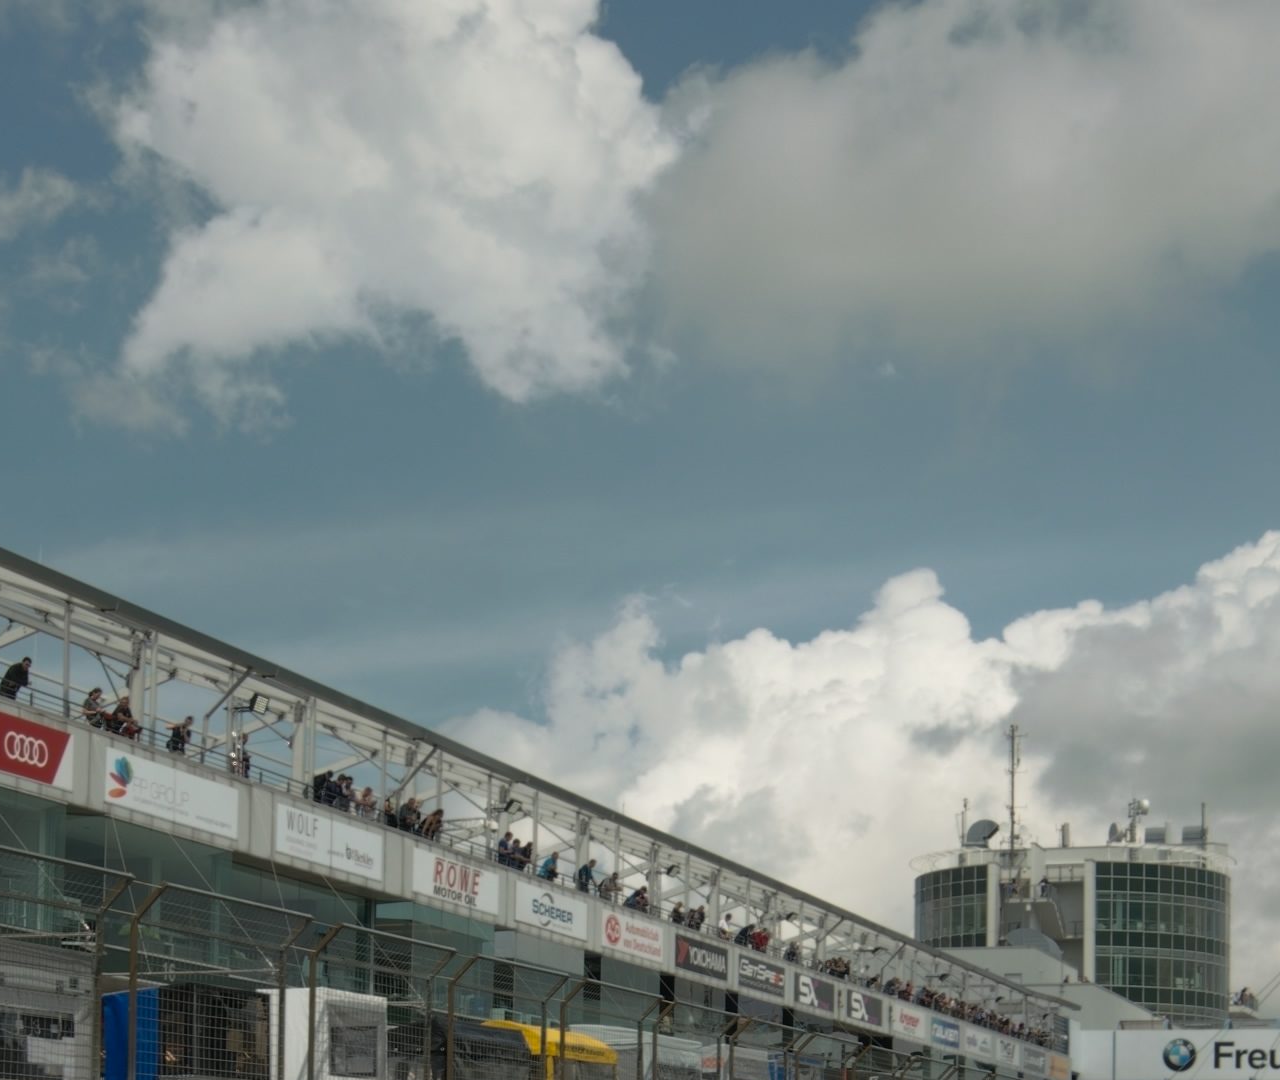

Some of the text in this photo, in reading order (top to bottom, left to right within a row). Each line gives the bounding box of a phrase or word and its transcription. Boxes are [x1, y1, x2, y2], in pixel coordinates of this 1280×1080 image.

[286, 807, 320, 839] WOLF
[433, 857, 481, 896] ROWE
[433, 884, 477, 908] MOTOR OIL
[532, 899, 573, 925] SCHERER
[689, 947, 726, 974] YOKOHAMA
